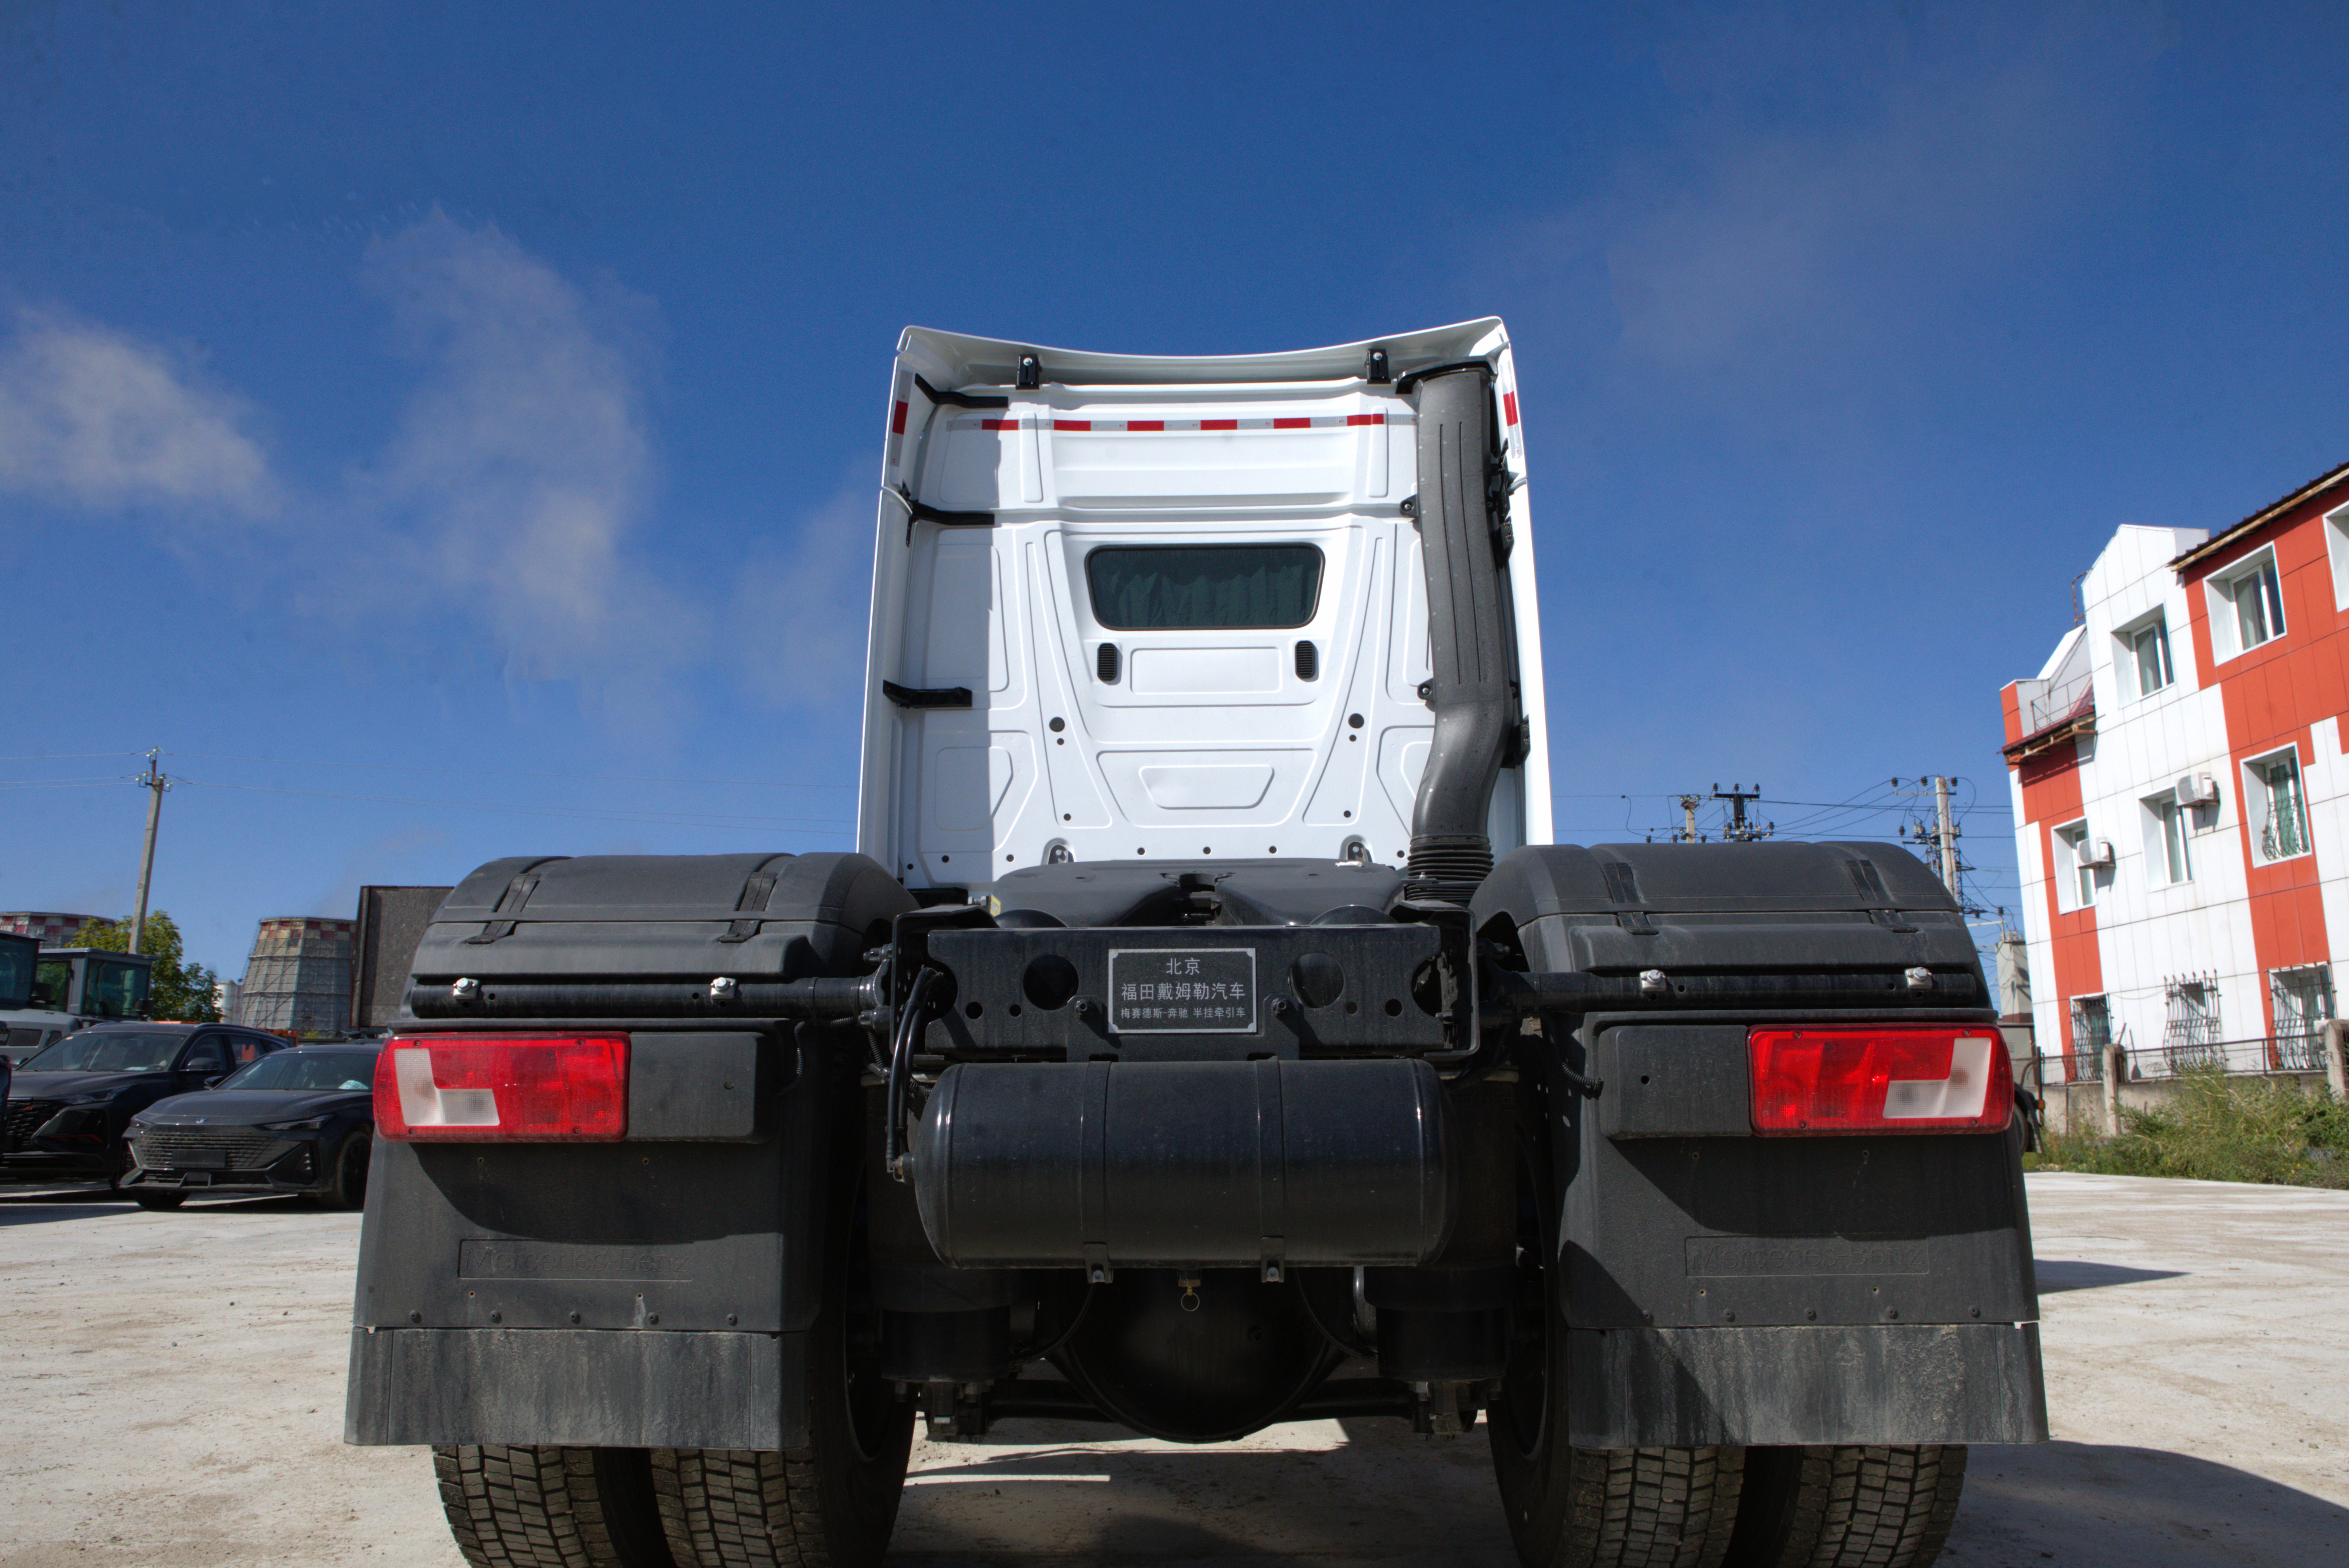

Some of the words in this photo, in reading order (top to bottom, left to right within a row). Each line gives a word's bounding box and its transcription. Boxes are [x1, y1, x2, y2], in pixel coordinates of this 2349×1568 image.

[1166, 958, 1200, 975] 北京
[1122, 982, 1245, 1001] 福田戴姆勒汽车
[1121, 1007, 1188, 1018] 梅赛德斯-奔驰
[1193, 1007, 1245, 1018] 半挂牵引车
[462, 1247, 691, 1272] Mercedes-Benz
[1690, 1244, 1925, 1270] Mercedes-Benz
